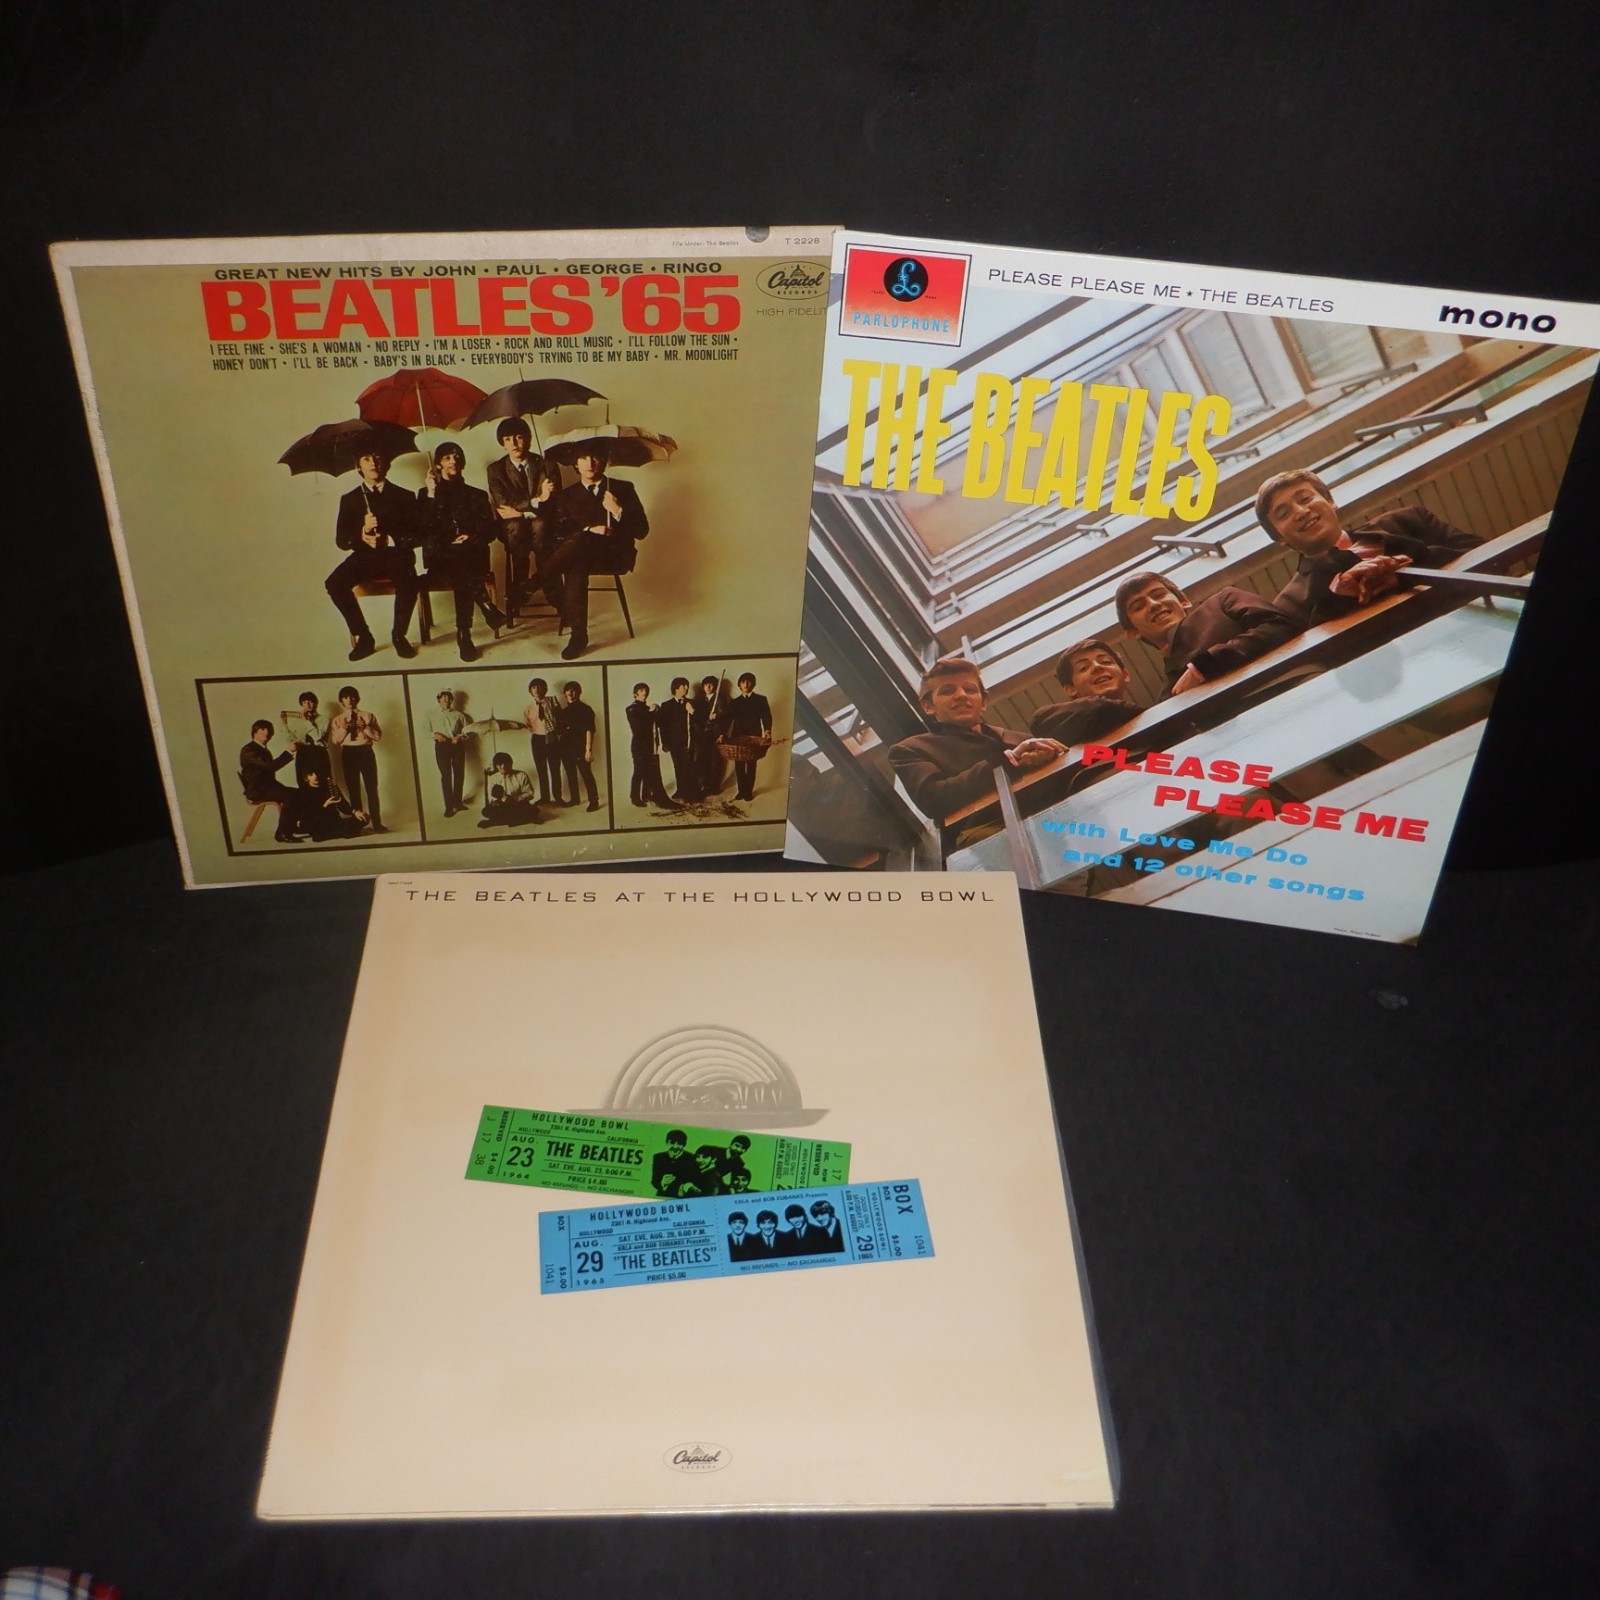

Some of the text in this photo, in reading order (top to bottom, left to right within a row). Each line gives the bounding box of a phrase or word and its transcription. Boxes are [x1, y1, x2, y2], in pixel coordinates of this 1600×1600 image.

[794, 237, 820, 245] 2228
[215, 262, 722, 280] GREAT NEW HITS BY JOHN PAUL GEORGE RINGO
[768, 271, 826, 290] Capitol
[988, 268, 1334, 313] PLEASE PLEASE ME THE BEATLES
[201, 274, 741, 341] BEATLES '65
[756, 307, 828, 316] HIGH FIDELIT
[1438, 304, 1557, 333] mono
[853, 311, 949, 333] PARLOPHONE
[210, 334, 730, 356] I FEEL FINE SHE'S A WOMAN NO REPLY I'M A LOSER ROCK AND ROLL MUSIC I'LL FOLLOW THE SUN
[213, 349, 739, 371] HONEY DON'T I'LL BE BACK BABY'S IN BLACK EVERYBODY'S TRYING TO BE MY BABY MR. MOONLIGHT
[842, 358, 1232, 522] THE BEATLES
[1082, 744, 1273, 788] PLEASE
[1153, 785, 1429, 843] PLEASE ME
[1041, 819, 1308, 866] with Love Me Do
[1063, 848, 1365, 901] and 12 other songs
[406, 891, 994, 902] THE BEATLES AT THE HOLLYWOOD BOWL
[532, 1112, 630, 1130] HOLLYWOOD BOWL
[486, 1110, 510, 1175] RESERVED $4.00
[512, 1135, 539, 1144] AUG.
[606, 1136, 638, 1144] CALIFORNIA
[506, 1146, 535, 1168] 23
[546, 1140, 644, 1165] THE BEATLES
[814, 1144, 822, 1176] RESERVED
[502, 1170, 530, 1180] 1964
[800, 1148, 808, 1184] HOLLYWOOD
[894, 1184, 914, 1214] BOX
[590, 1204, 691, 1221] HOLLYWOOD BOWL
[872, 1192, 883, 1232] HOLLYWOOD
[883, 1186, 902, 1256] BOX $5.00
[579, 1228, 614, 1236] HOLLYWOOD
[672, 1220, 706, 1228] CALIFORNIA
[574, 1241, 603, 1249] AUG.
[856, 1235, 874, 1252] 29
[576, 1250, 604, 1274] 29
[559, 1266, 567, 1289] $5.00
[647, 1272, 666, 1282] PRICE
[673, 1450, 722, 1465] Capitol
